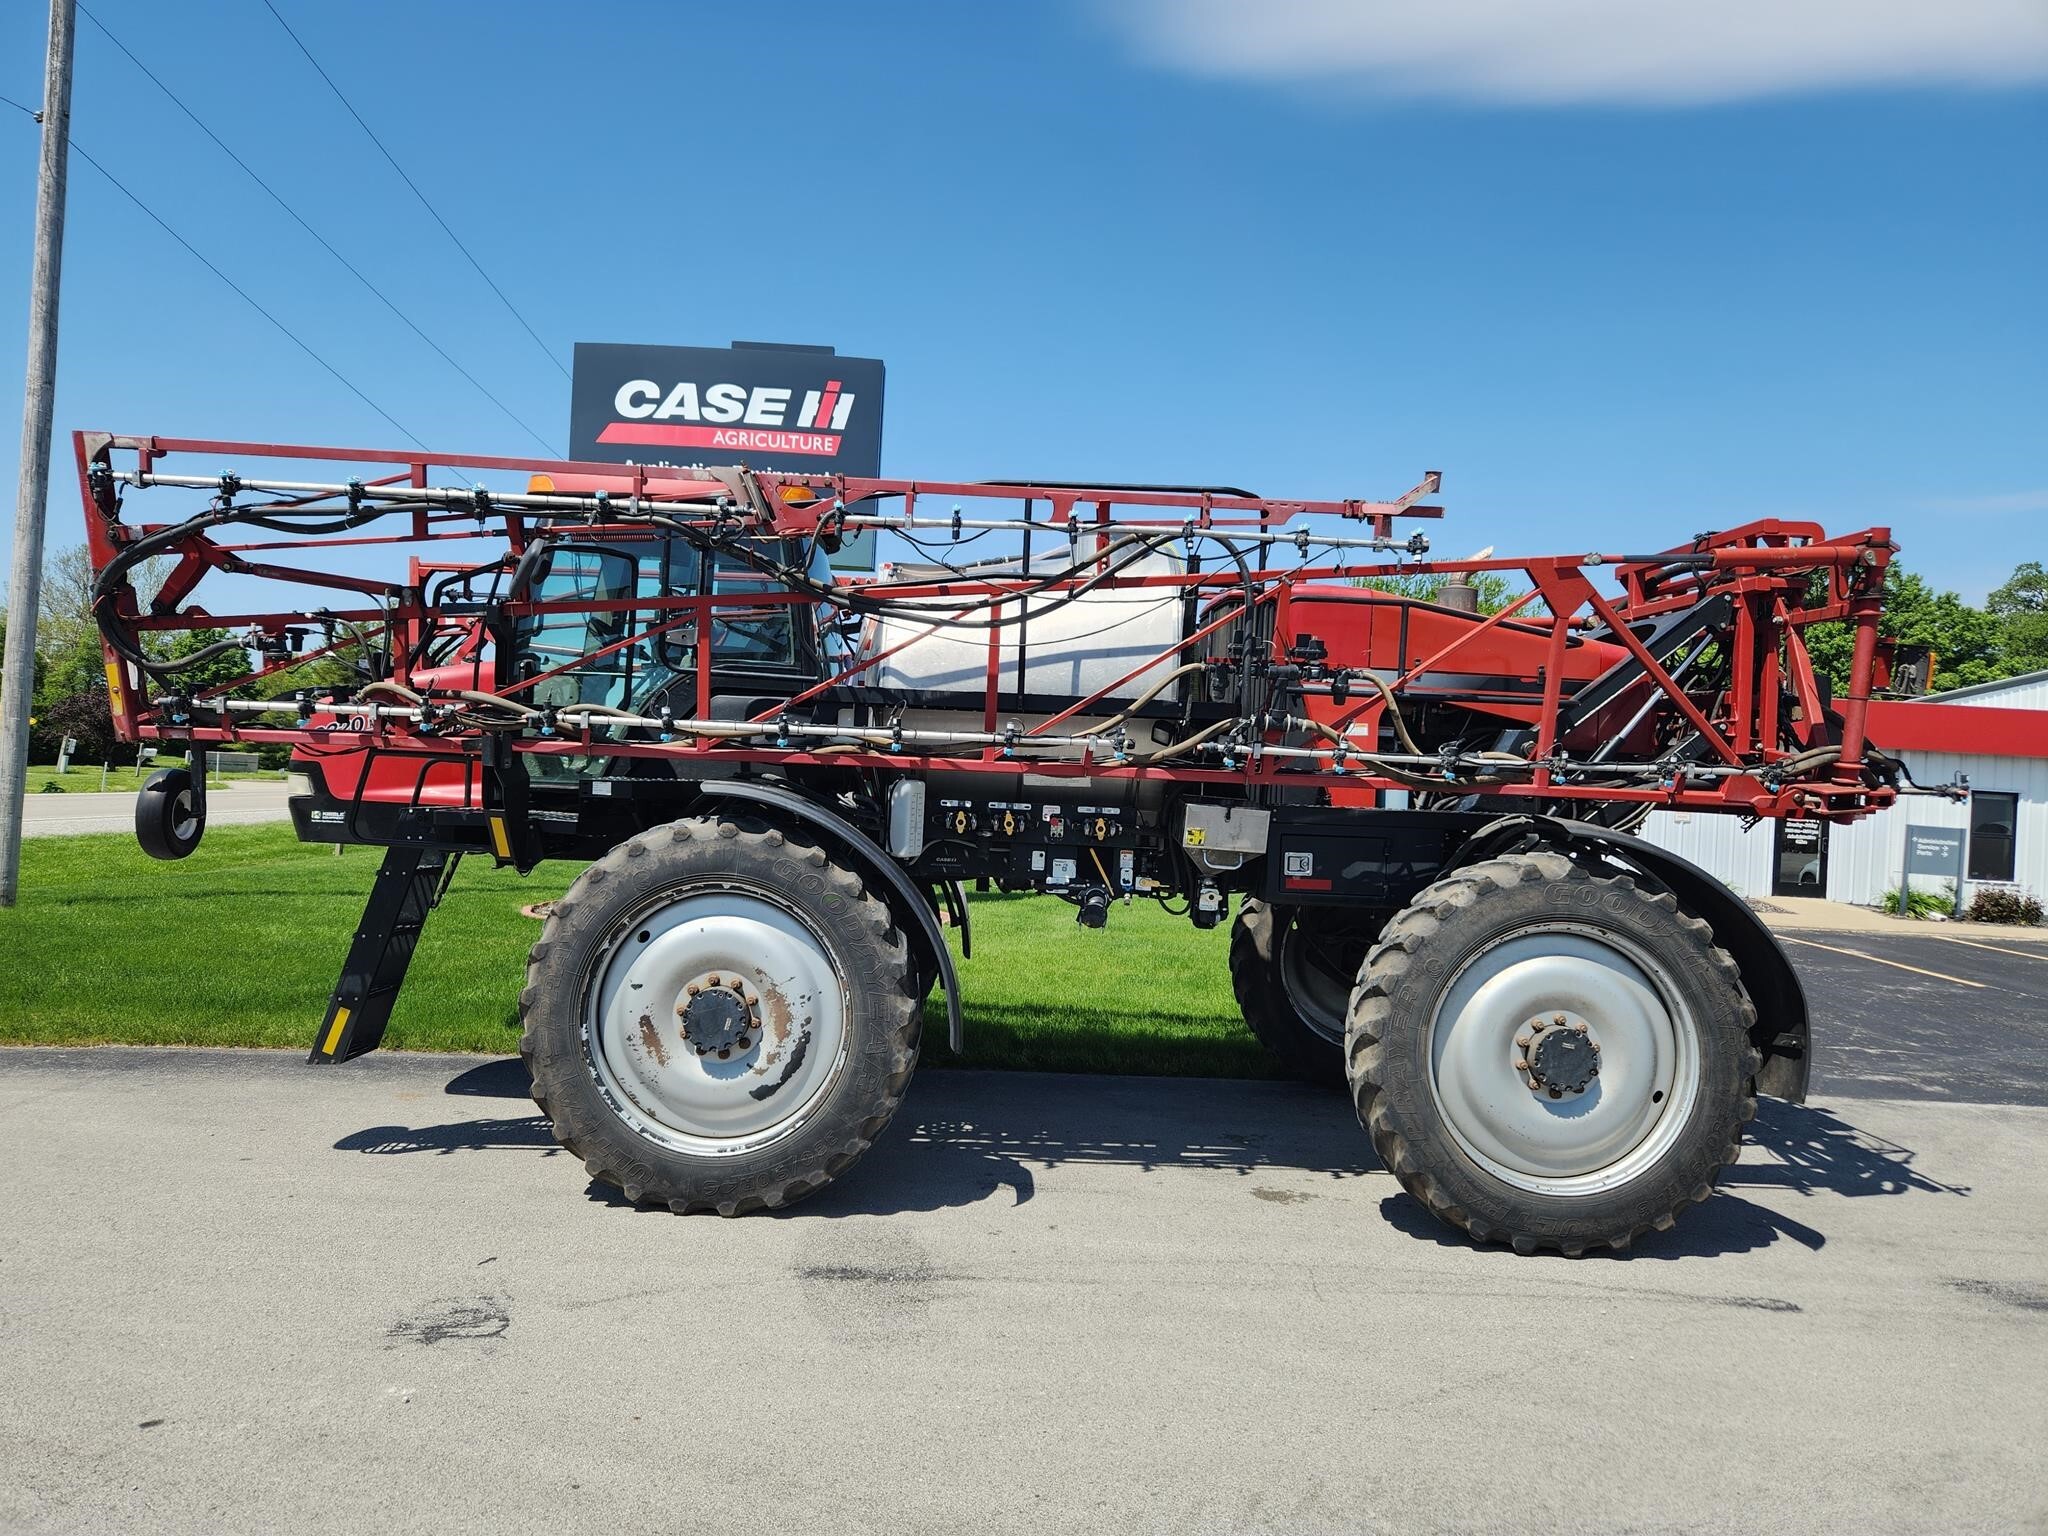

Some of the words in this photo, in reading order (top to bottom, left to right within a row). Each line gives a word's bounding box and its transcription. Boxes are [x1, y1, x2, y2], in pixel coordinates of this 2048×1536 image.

[614, 379, 792, 426] CASE
[713, 430, 834, 452] AGRICULTURE
[773, 858, 890, 1093] GOODYEAR
[1544, 883, 1738, 1056] GOODYEAR
